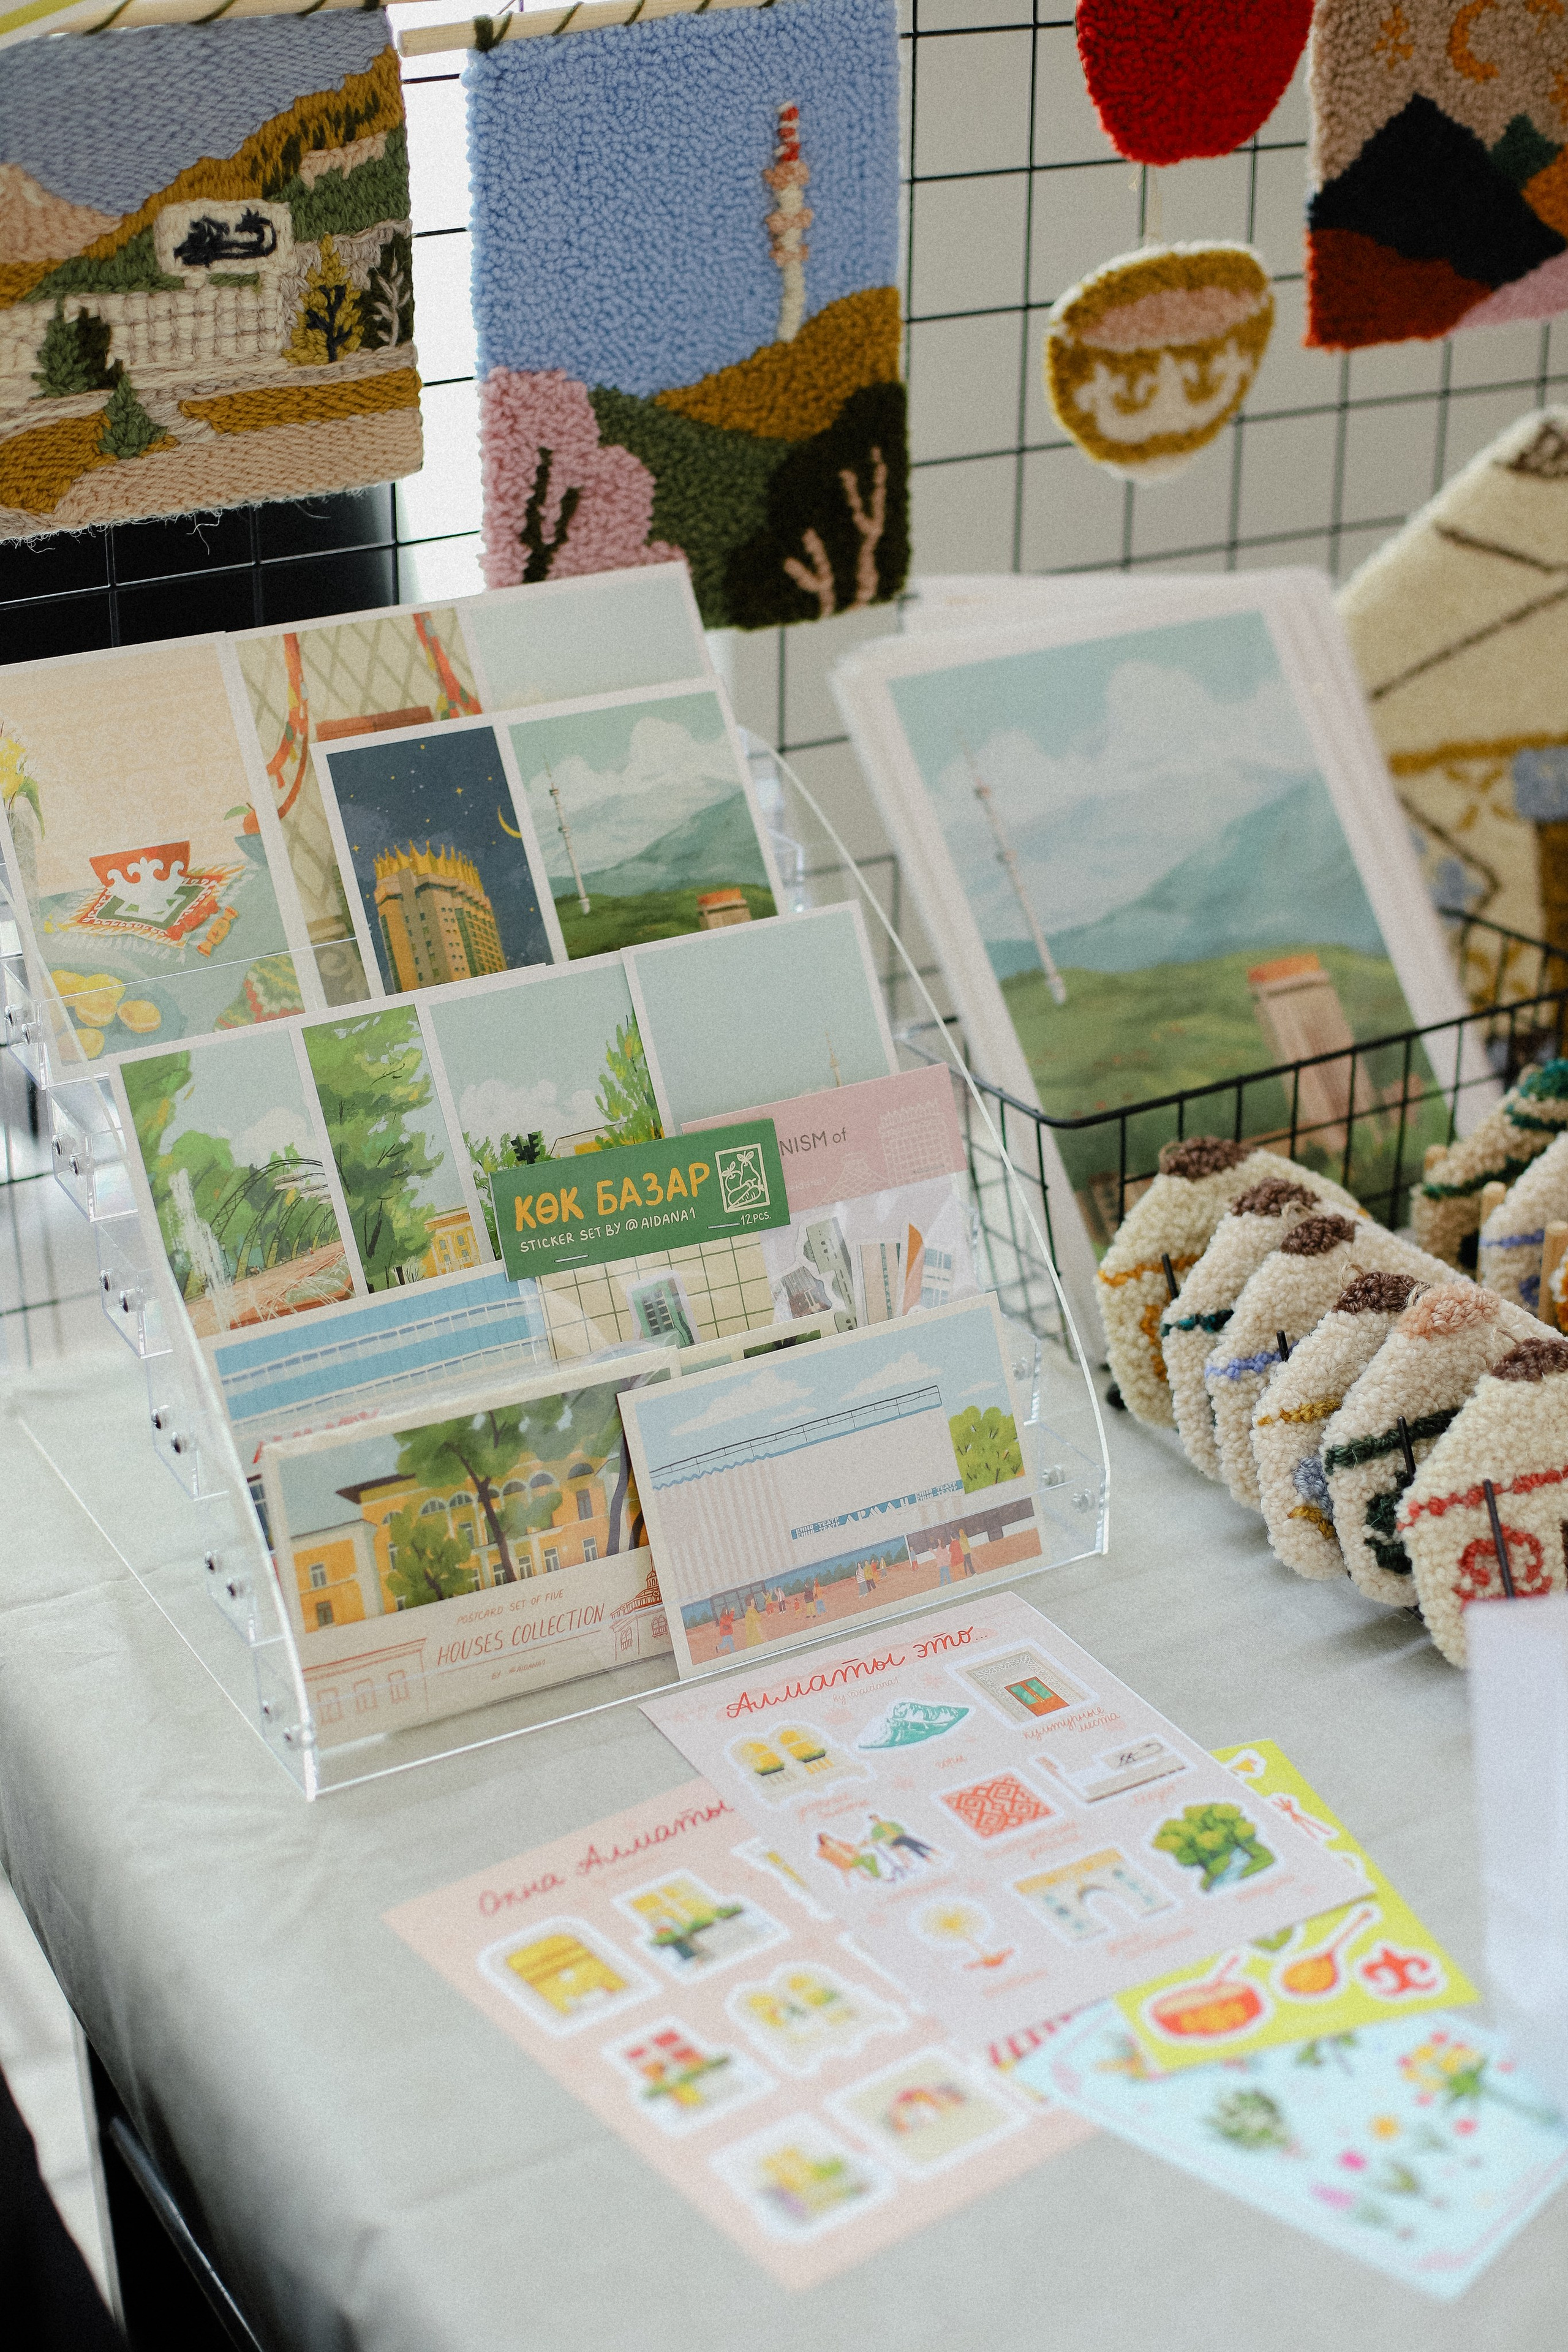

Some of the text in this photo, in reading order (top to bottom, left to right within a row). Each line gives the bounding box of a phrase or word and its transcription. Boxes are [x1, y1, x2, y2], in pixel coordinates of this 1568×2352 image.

[832, 1127, 846, 1144] of
[514, 1162, 710, 1232] КӨК БАЗАР
[520, 1232, 575, 1253] STICKER
[579, 1226, 601, 1241] SET
[605, 1221, 621, 1237] BY
[456, 1589, 564, 1624] POSTCARD SET OF FIVE
[437, 1602, 605, 1666] HOUSES COLLECTION
[726, 1653, 906, 1719] Алматы
[1078, 1712, 1121, 1733] места
[479, 1872, 566, 1917] Окна
[576, 1800, 735, 1877] Алматы
